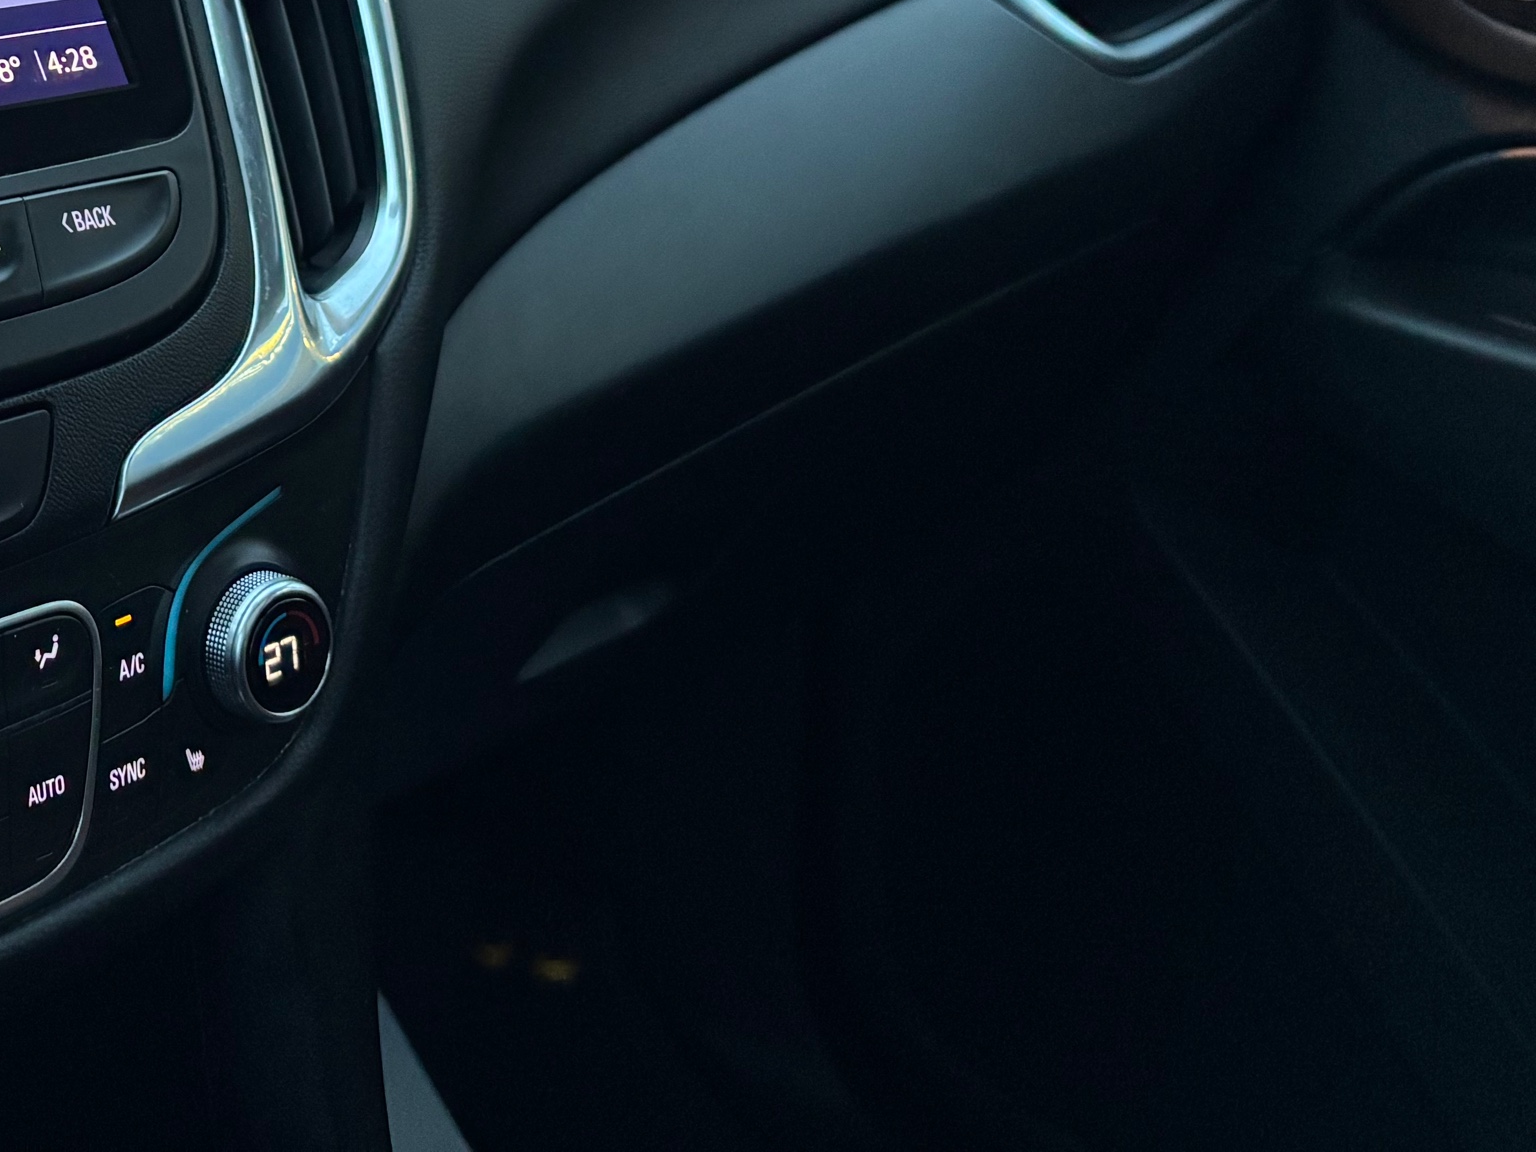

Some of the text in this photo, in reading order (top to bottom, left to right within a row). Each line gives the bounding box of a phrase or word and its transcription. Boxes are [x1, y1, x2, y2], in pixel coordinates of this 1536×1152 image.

[46, 46, 98, 76] 4:28
[71, 204, 117, 233] BACK
[119, 652, 146, 682] A/C
[263, 635, 299, 682] 27
[109, 757, 146, 791] SYNC
[28, 774, 66, 807] AUTO
